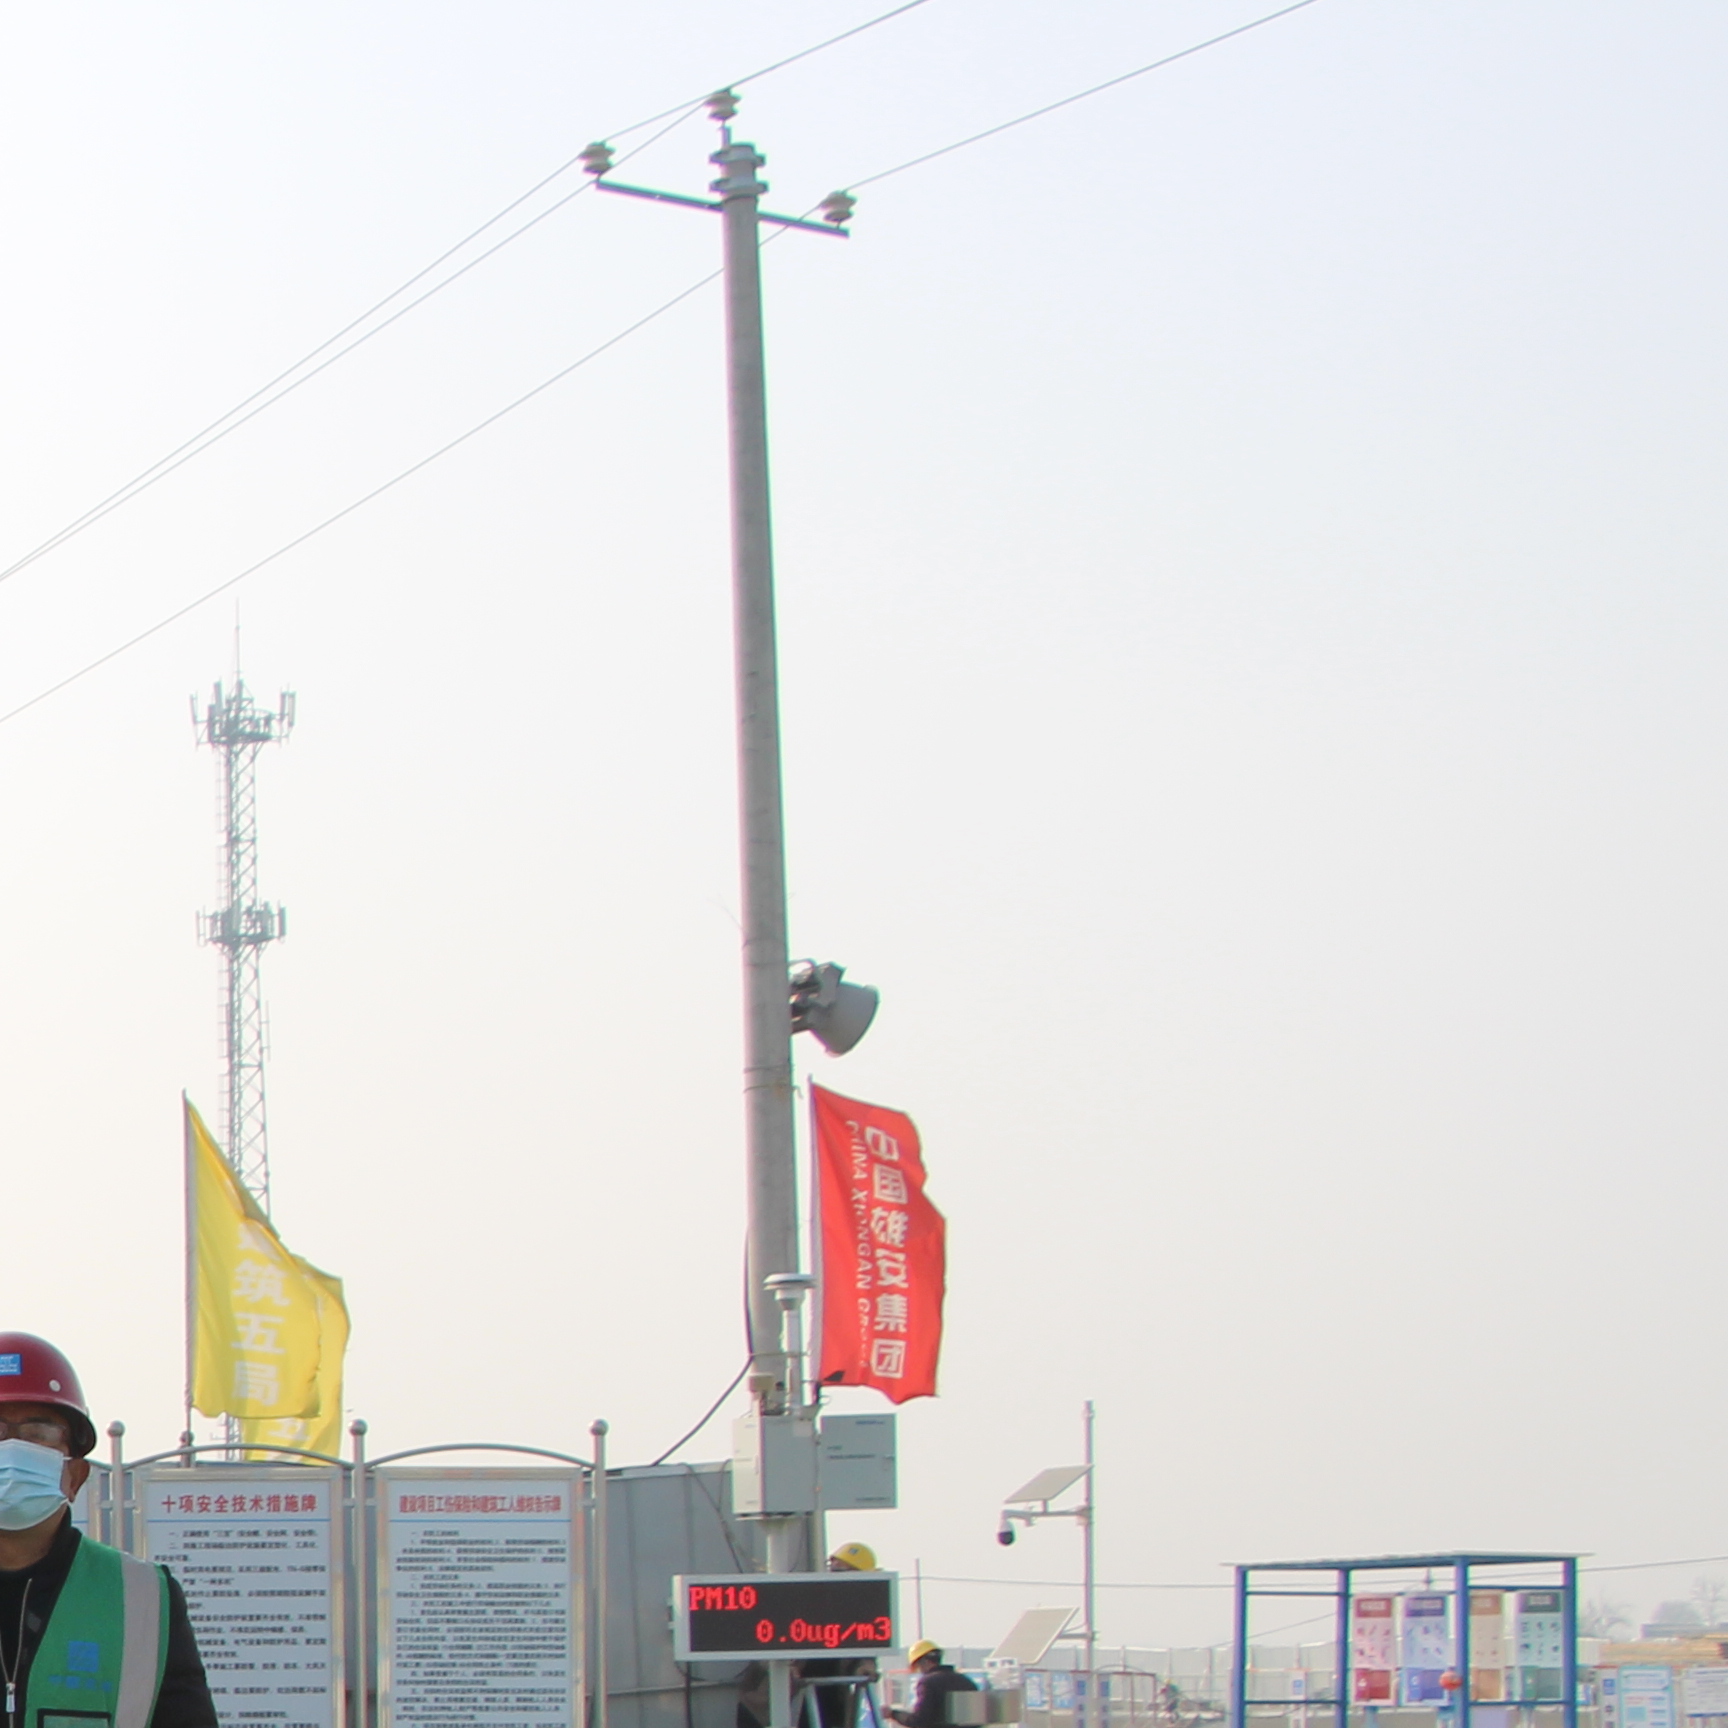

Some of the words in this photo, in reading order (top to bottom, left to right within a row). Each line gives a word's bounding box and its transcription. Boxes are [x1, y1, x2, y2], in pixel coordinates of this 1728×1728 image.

[866, 1126, 909, 1379] 中国雄安集团
[162, 1495, 317, 1513] 十项安全技术措施牌
[689, 1585, 757, 1610] PM10
